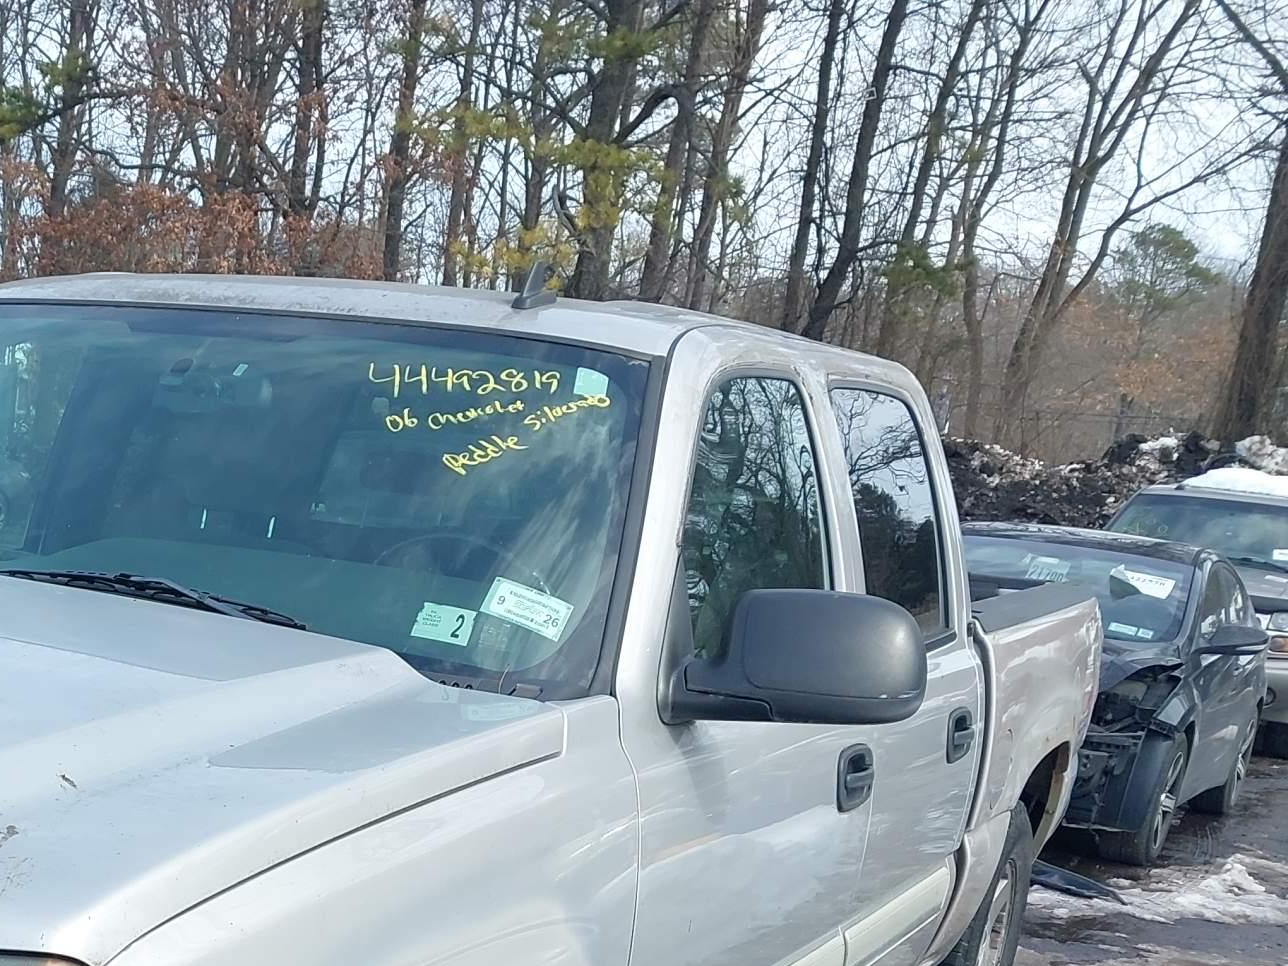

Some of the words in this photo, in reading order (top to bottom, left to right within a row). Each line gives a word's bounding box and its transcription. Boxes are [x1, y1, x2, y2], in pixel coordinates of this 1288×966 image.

[369, 362, 560, 397] 44492819
[386, 407, 418, 432] 06
[496, 595, 506, 606] 9
[450, 613, 466, 639] 2
[543, 614, 560, 628] 26
